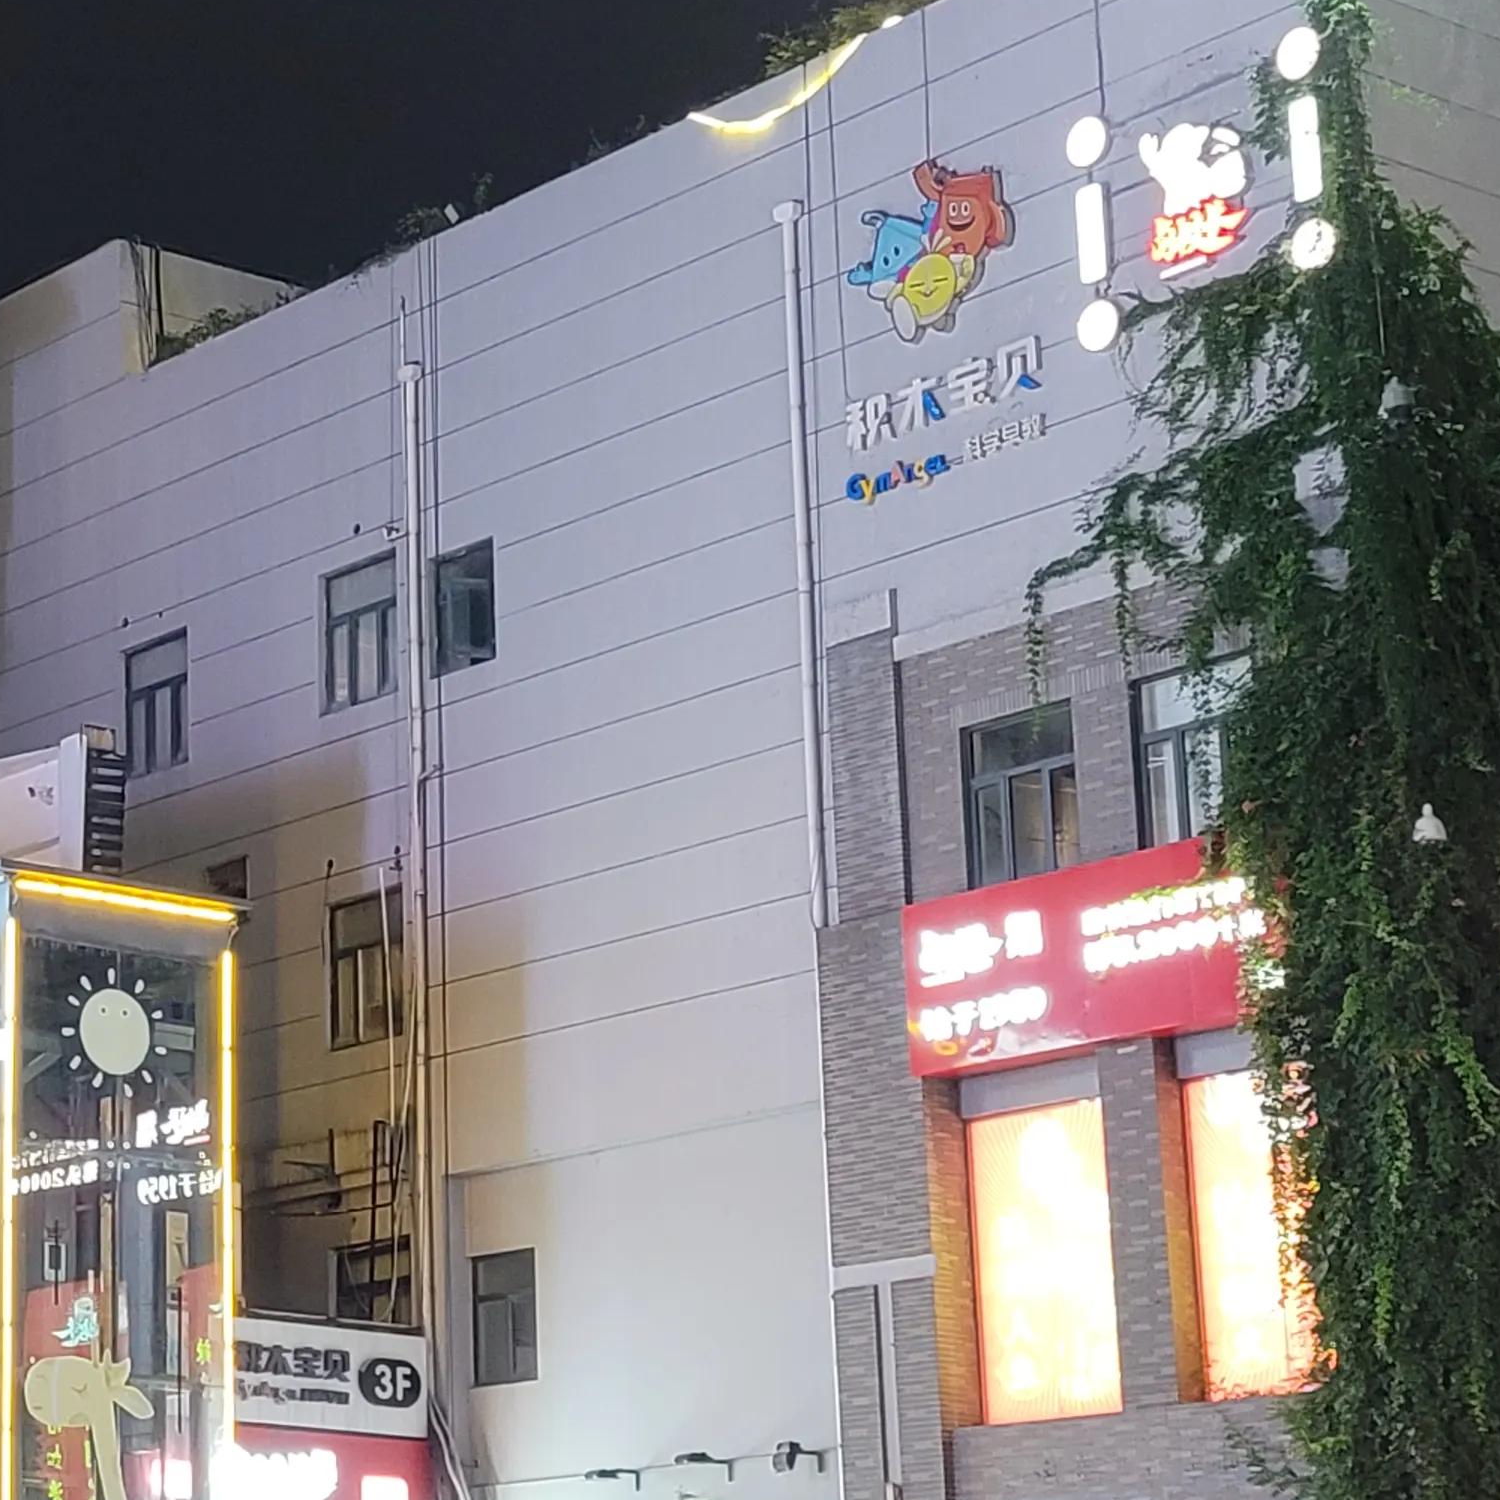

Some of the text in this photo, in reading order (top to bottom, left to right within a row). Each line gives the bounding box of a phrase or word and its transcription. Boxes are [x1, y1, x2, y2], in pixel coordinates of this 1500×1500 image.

[846, 335, 1042, 452] 积木宝贝
[374, 1363, 412, 1401] 3F
